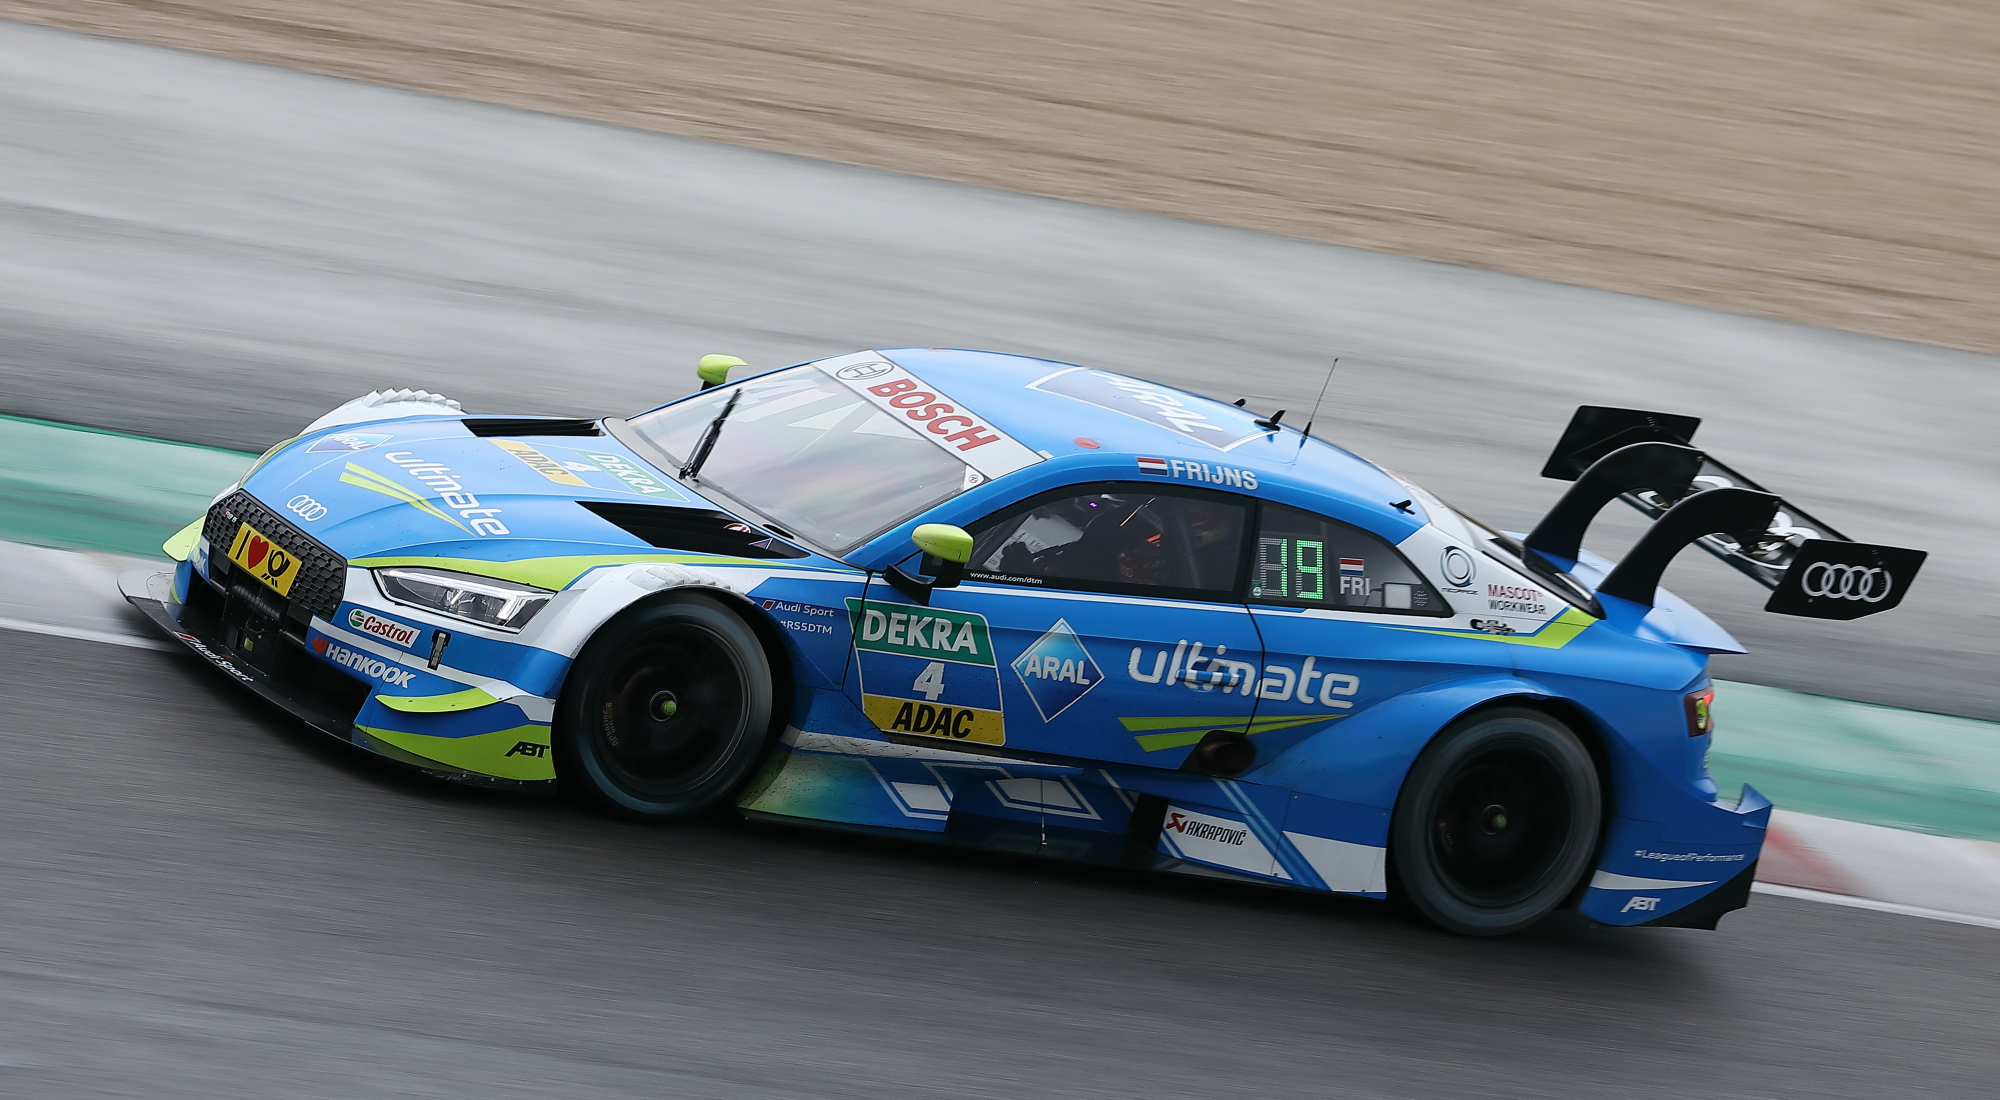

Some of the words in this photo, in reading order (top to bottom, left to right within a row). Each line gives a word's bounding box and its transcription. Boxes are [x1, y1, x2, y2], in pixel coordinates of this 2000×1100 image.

[866, 378, 1002, 452] BOSCH
[1090, 371, 1224, 433] ARAL
[328, 434, 372, 450] ARAL
[507, 449, 569, 476] ADAC
[562, 461, 603, 472] 4
[588, 454, 667, 494] DEKRA
[1169, 459, 1259, 491] FRIJNS
[384, 451, 510, 536] ultimate
[235, 530, 251, 560] I
[970, 571, 1043, 585] www.audi.com/dtm
[1339, 576, 1371, 596] FRI
[775, 601, 801, 613] Audi
[803, 605, 834, 617] Sport
[1488, 599, 1547, 615] WORKWEAR
[363, 615, 415, 645] Castrol
[862, 609, 978, 655] DEKRA
[215, 659, 254, 682] Sport
[912, 661, 946, 701] 4
[1024, 653, 1091, 686] ARAL
[1127, 639, 1361, 709] ultimate
[890, 702, 974, 739] ADAC
[504, 740, 550, 758] ABT
[1620, 896, 1661, 913] ABT
